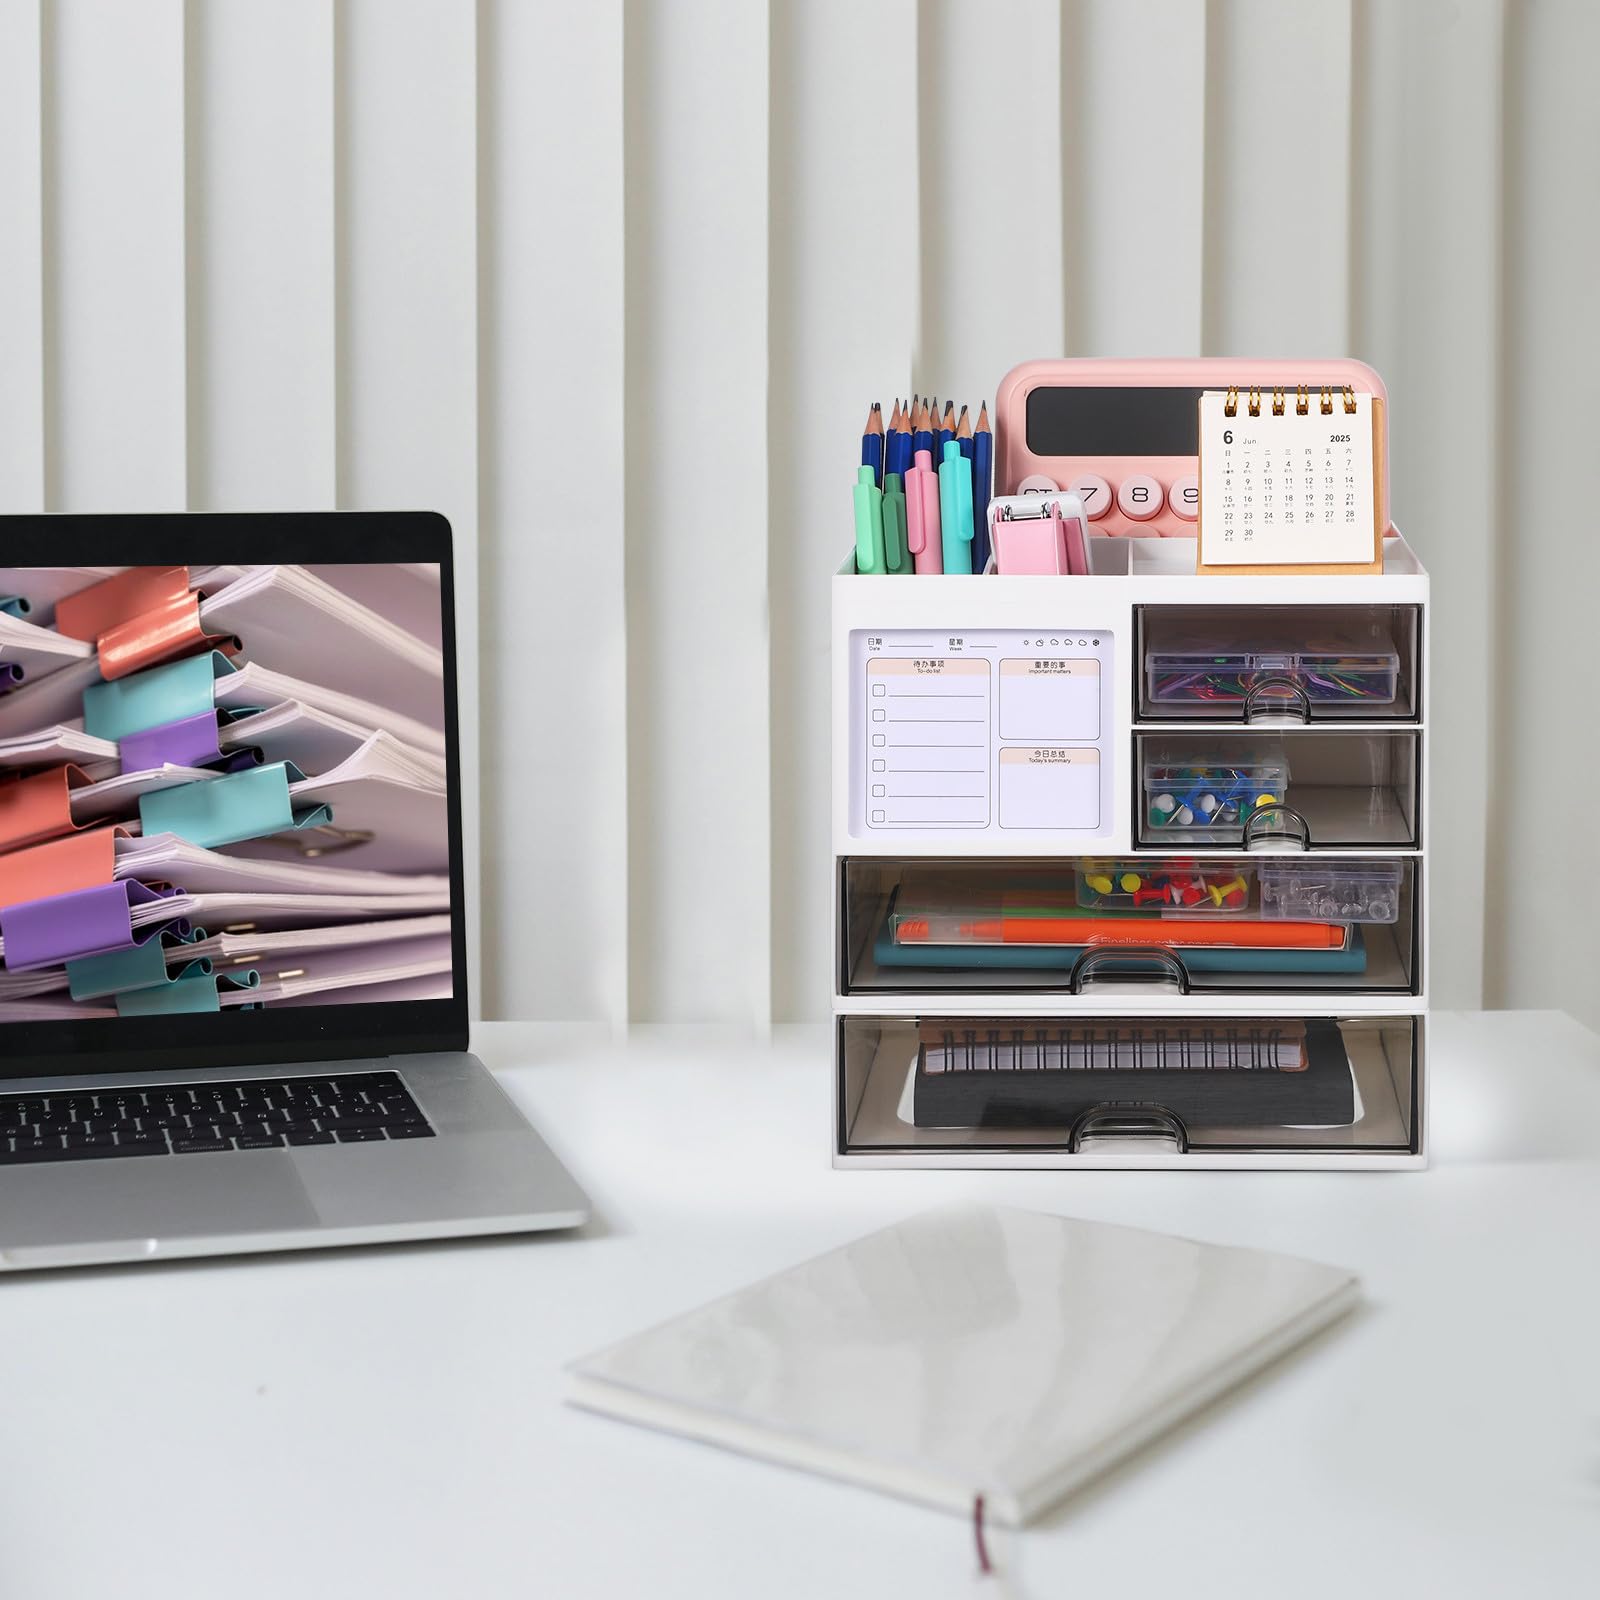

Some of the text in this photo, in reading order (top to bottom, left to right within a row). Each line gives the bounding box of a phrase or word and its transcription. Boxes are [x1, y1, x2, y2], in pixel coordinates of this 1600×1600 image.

[1223, 430, 1234, 445] 6
[1330, 434, 1351, 443] 2025
[1224, 449, 1231, 457] 日
[1226, 461, 1230, 469] 1
[1245, 461, 1250, 469] 2
[1265, 460, 1271, 468] 3
[1306, 459, 1312, 468] 5
[1325, 459, 1332, 467] 6
[1346, 458, 1352, 466] 7
[1225, 478, 1231, 486] 8
[1245, 478, 1251, 486] 9
[1264, 477, 1273, 485] 10
[1305, 477, 1314, 485] 12
[1325, 476, 1334, 484] 13
[1080, 487, 1198, 503] 7 8 9
[1224, 493, 1354, 503] 15 16 17 18 19 20 21
[1224, 510, 1355, 520] 22 23 24 25 26 27 28
[1224, 528, 1254, 537] 29 30
[867, 637, 883, 646] 日期
[913, 660, 945, 668] 待办事项
[1034, 661, 1066, 669] 重要的事
